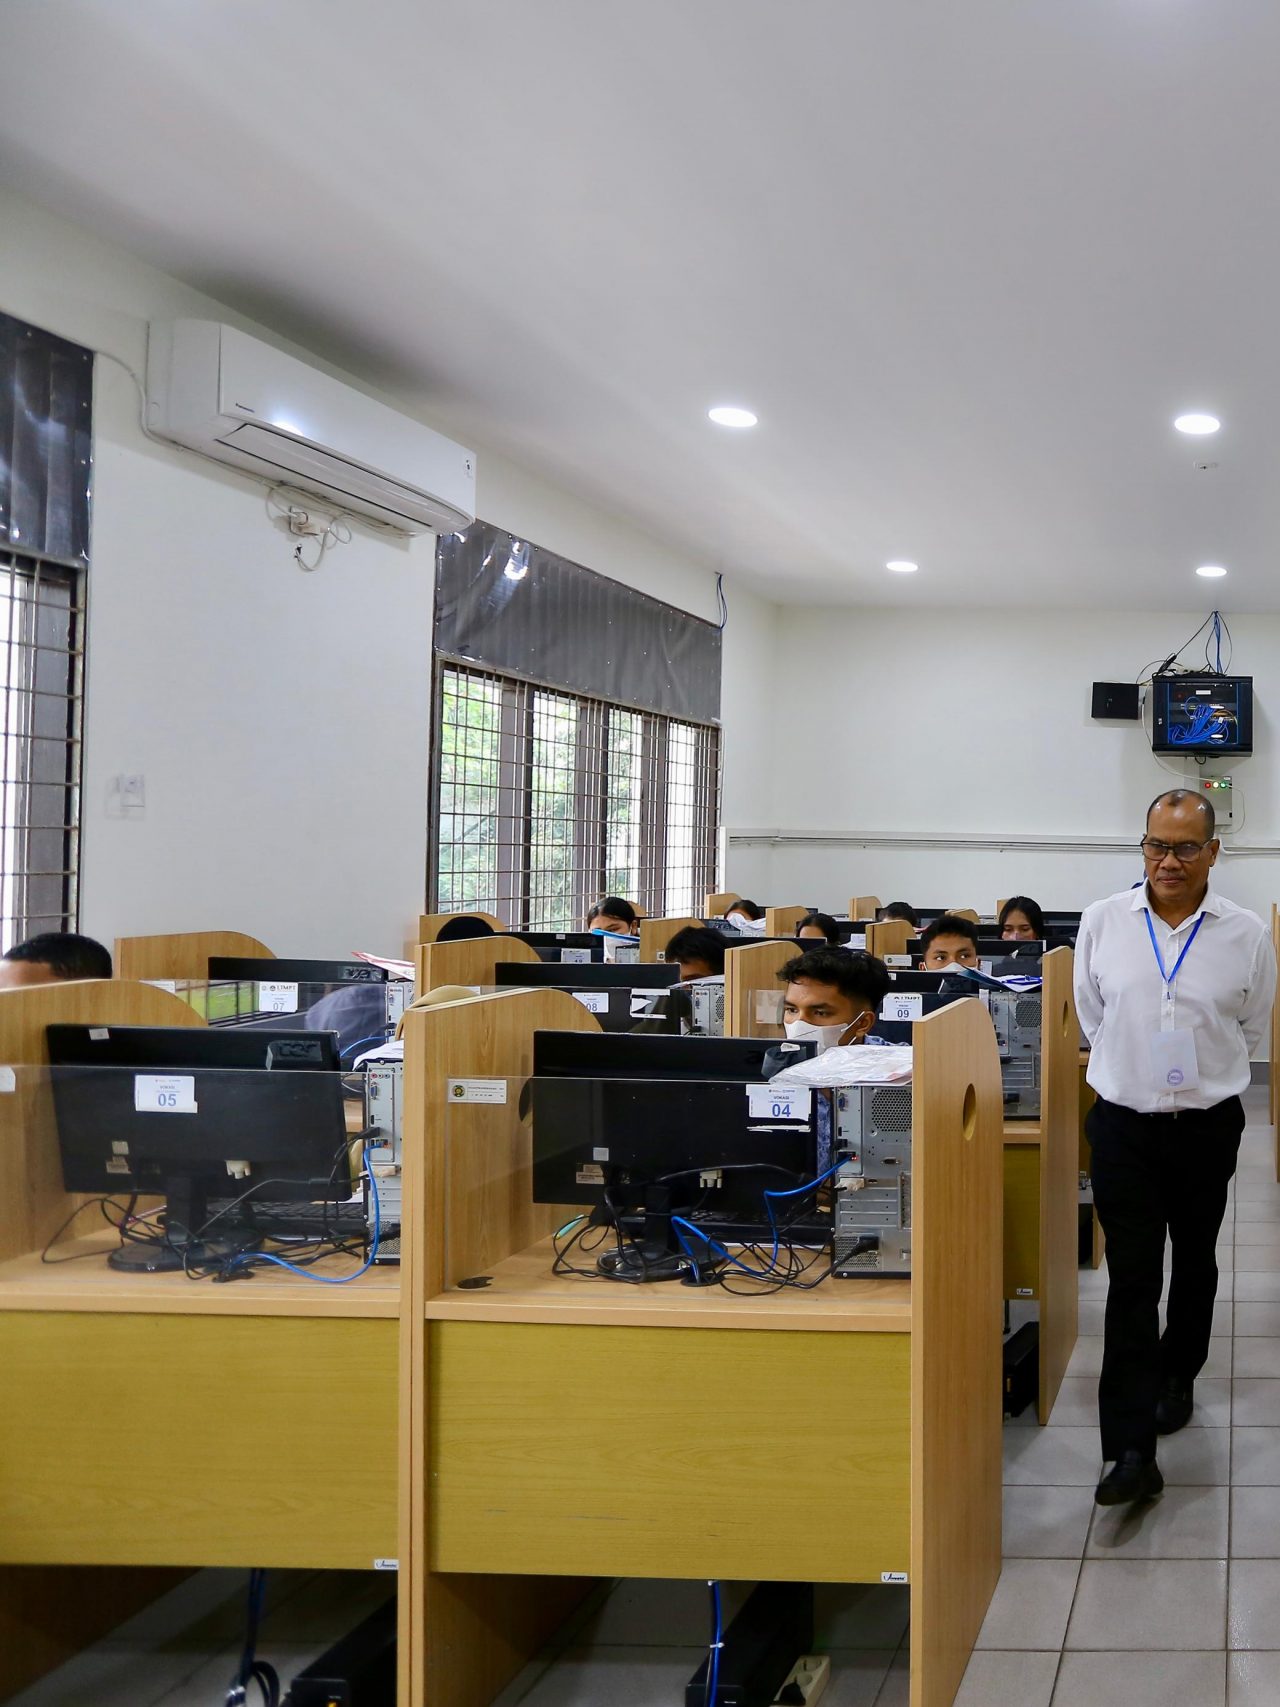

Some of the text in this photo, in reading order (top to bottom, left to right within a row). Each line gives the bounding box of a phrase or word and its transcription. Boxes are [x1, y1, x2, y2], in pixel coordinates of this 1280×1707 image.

[273, 1002, 286, 1012] 07
[897, 1009, 910, 1019] 09
[157, 1093, 178, 1107] 05
[771, 1103, 792, 1118] 04
